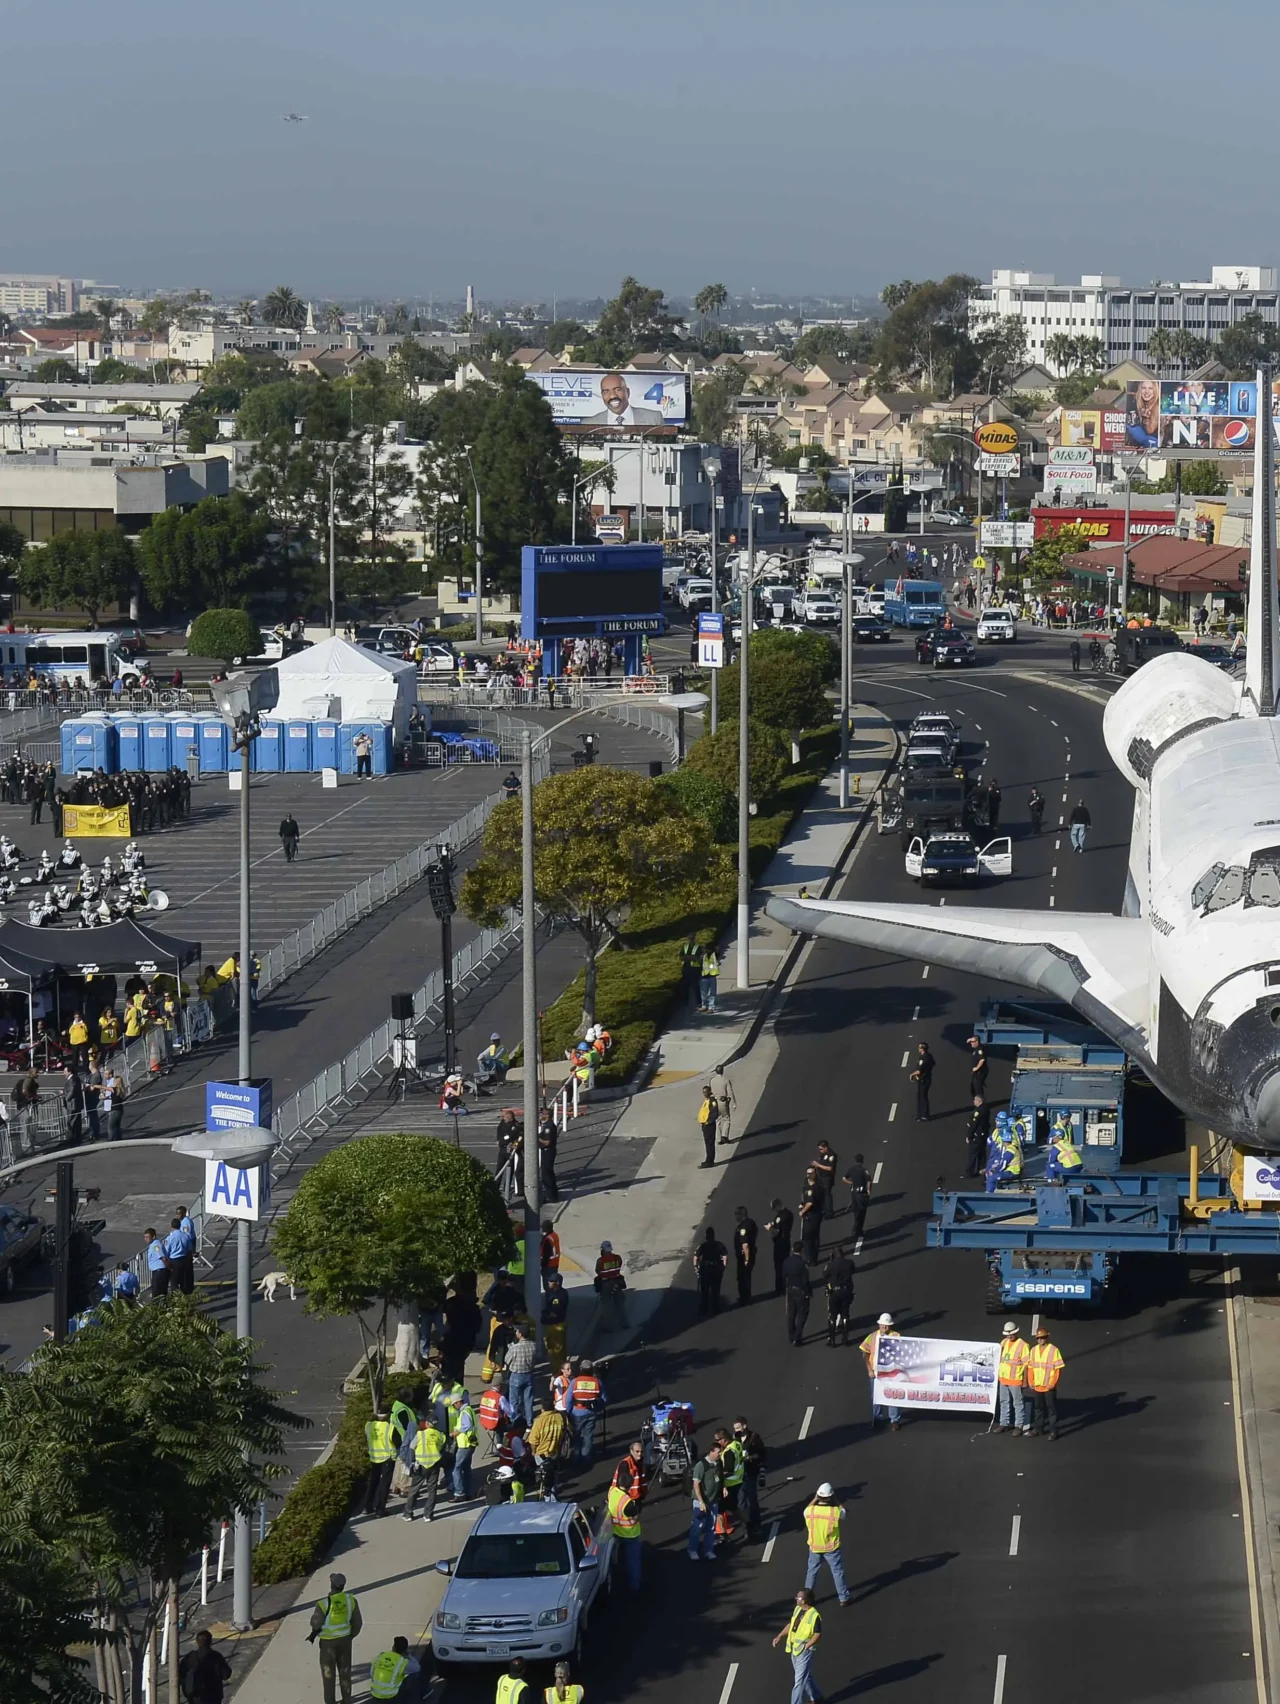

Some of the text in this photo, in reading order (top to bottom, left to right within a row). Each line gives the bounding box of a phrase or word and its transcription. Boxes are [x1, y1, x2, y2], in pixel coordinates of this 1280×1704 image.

[525, 376, 592, 389] TEVE
[1173, 392, 1216, 405] LIVE
[1104, 412, 1126, 422] CHOOS
[1104, 423, 1125, 433] WEIG
[980, 430, 1017, 444] MIDAS
[1053, 451, 1088, 461] M&M
[1047, 470, 1093, 479] SOUL FOOD
[1129, 524, 1157, 535] AUTO
[538, 553, 595, 563] THE FORUM
[603, 620, 658, 631] THE FORUM
[704, 644, 718, 662] LL
[215, 1090, 251, 1103] Welcome to
[215, 1118, 228, 1127] THE
[212, 1161, 253, 1208] AA
[1024, 1283, 1086, 1294] sarens
[939, 1362, 995, 1383] HHS
[883, 1387, 991, 1404] GOD BLESS AMERICA
